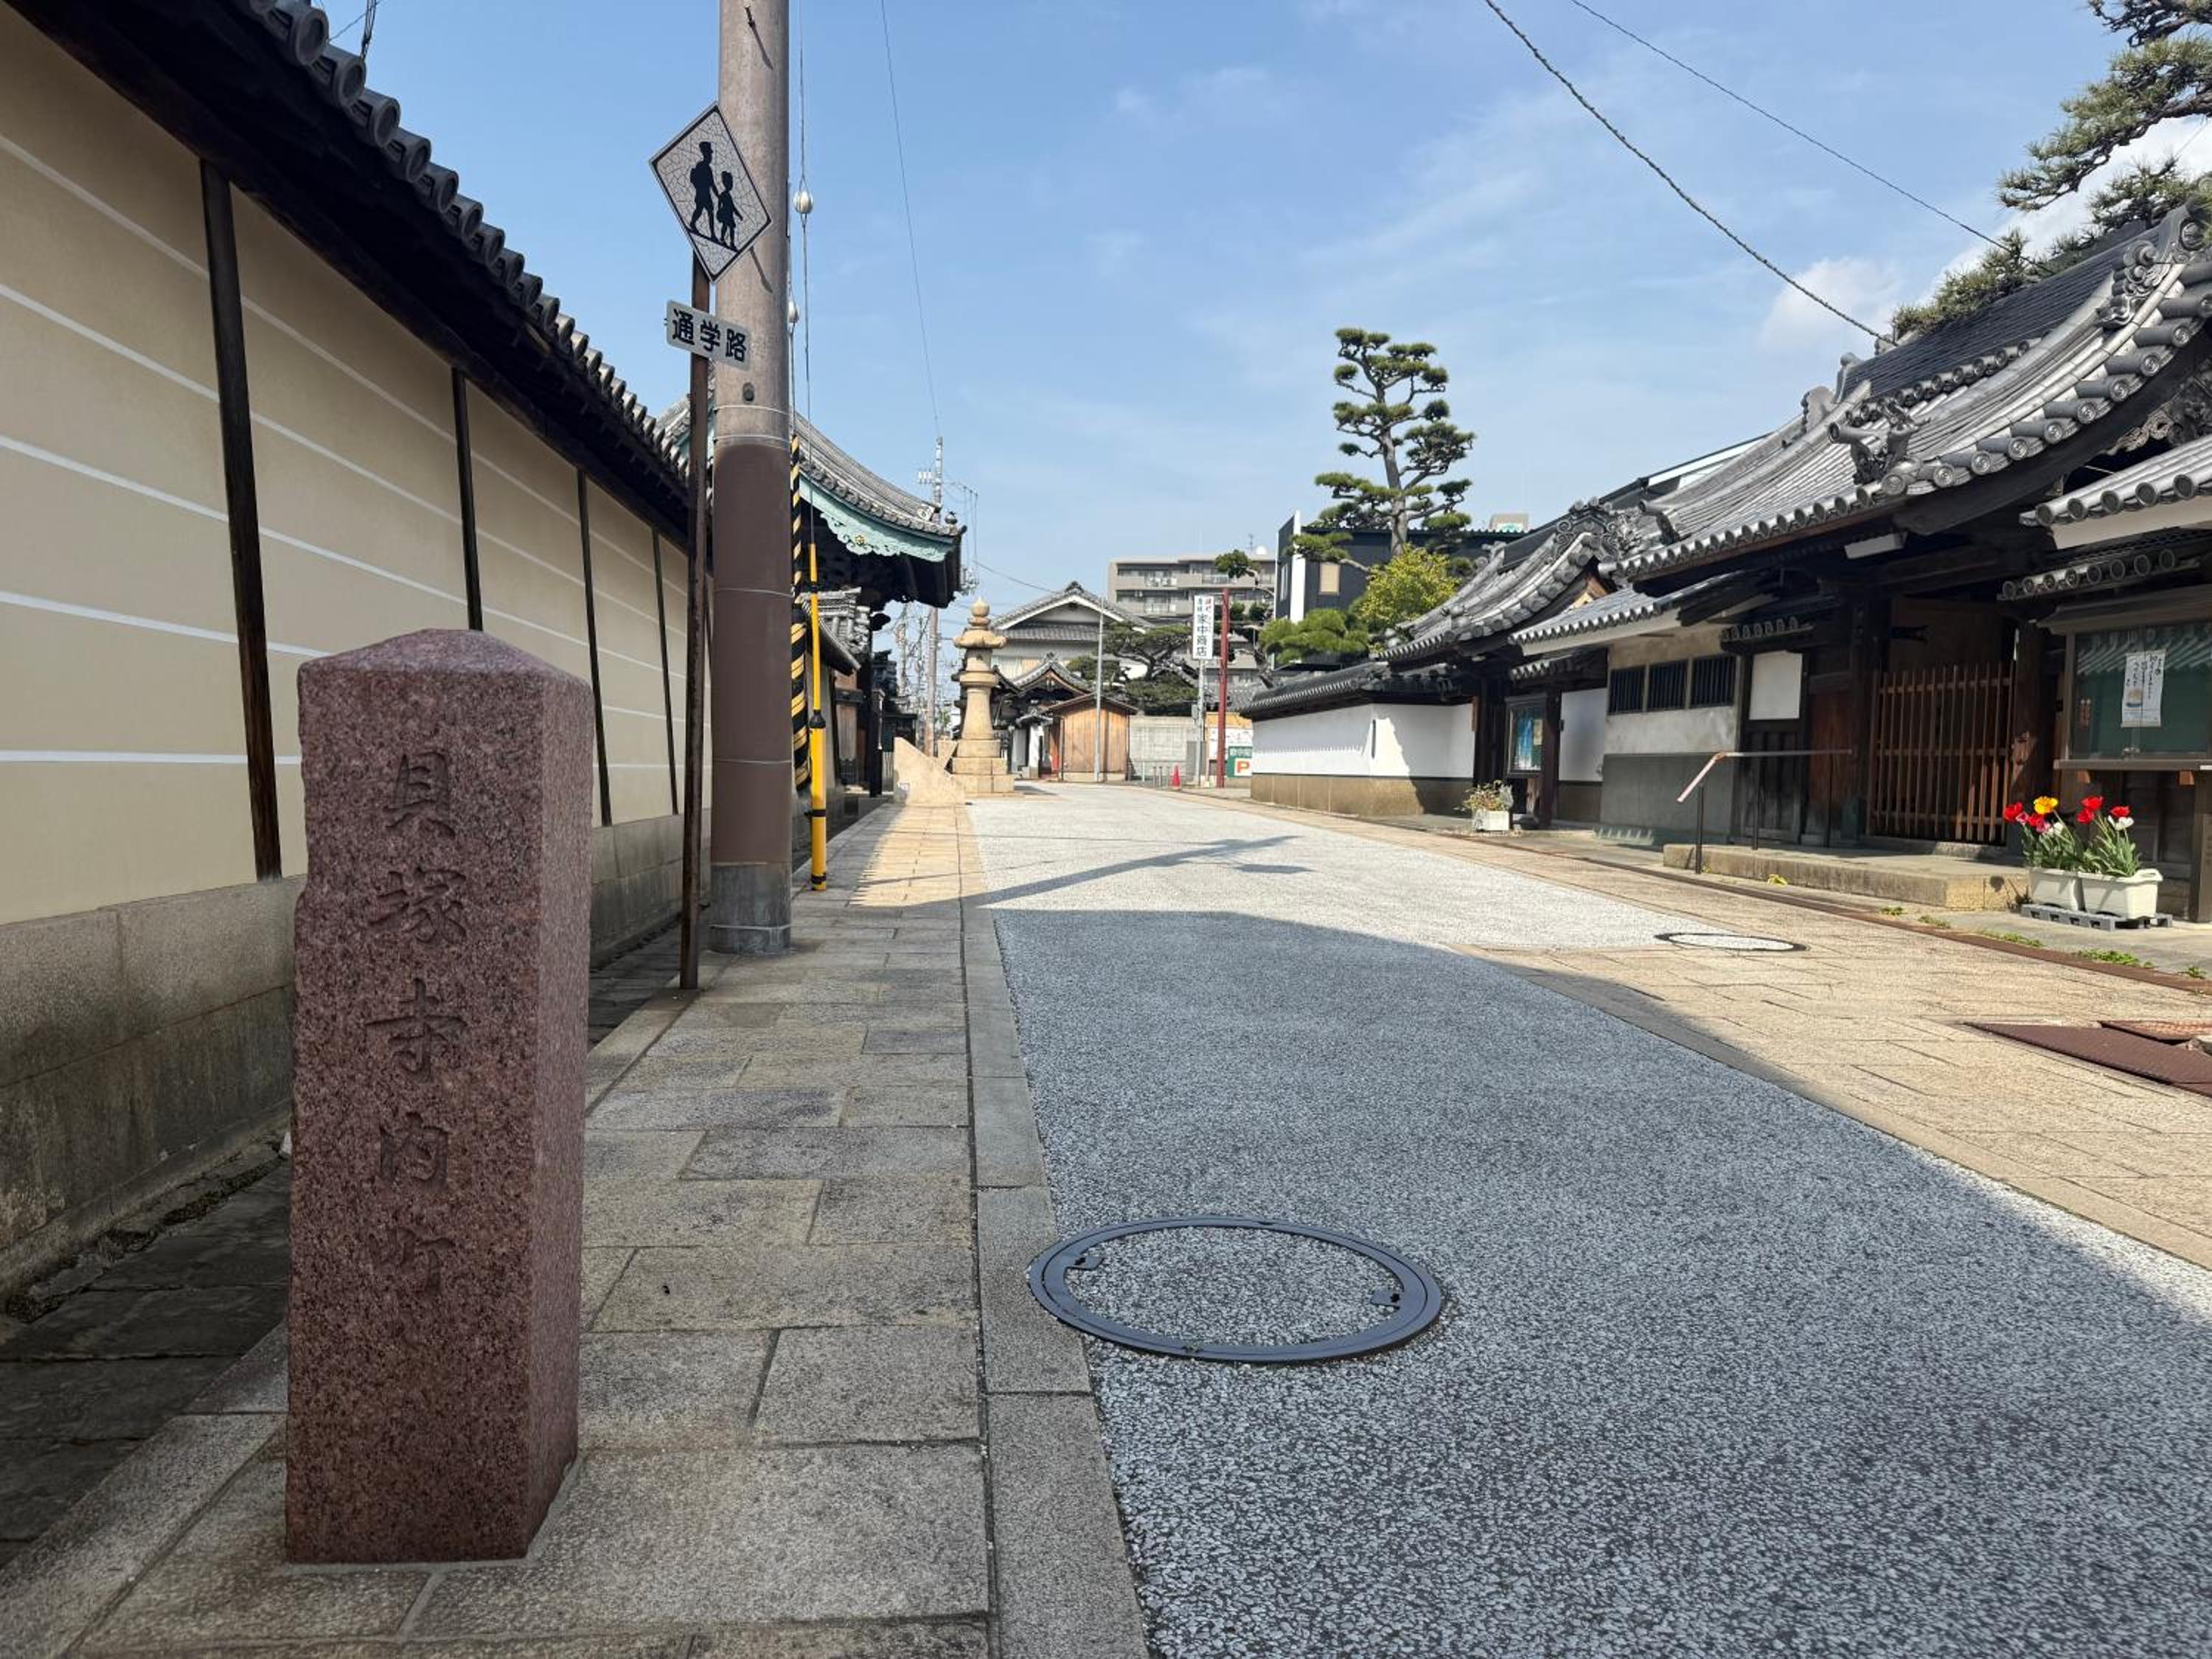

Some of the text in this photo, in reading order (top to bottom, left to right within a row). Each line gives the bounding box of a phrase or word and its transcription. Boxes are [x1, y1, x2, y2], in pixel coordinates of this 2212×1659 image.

[672, 307, 747, 363] 通学路
[1237, 761, 1251, 773] P
[366, 749, 467, 1296] 貝塚寺内町
